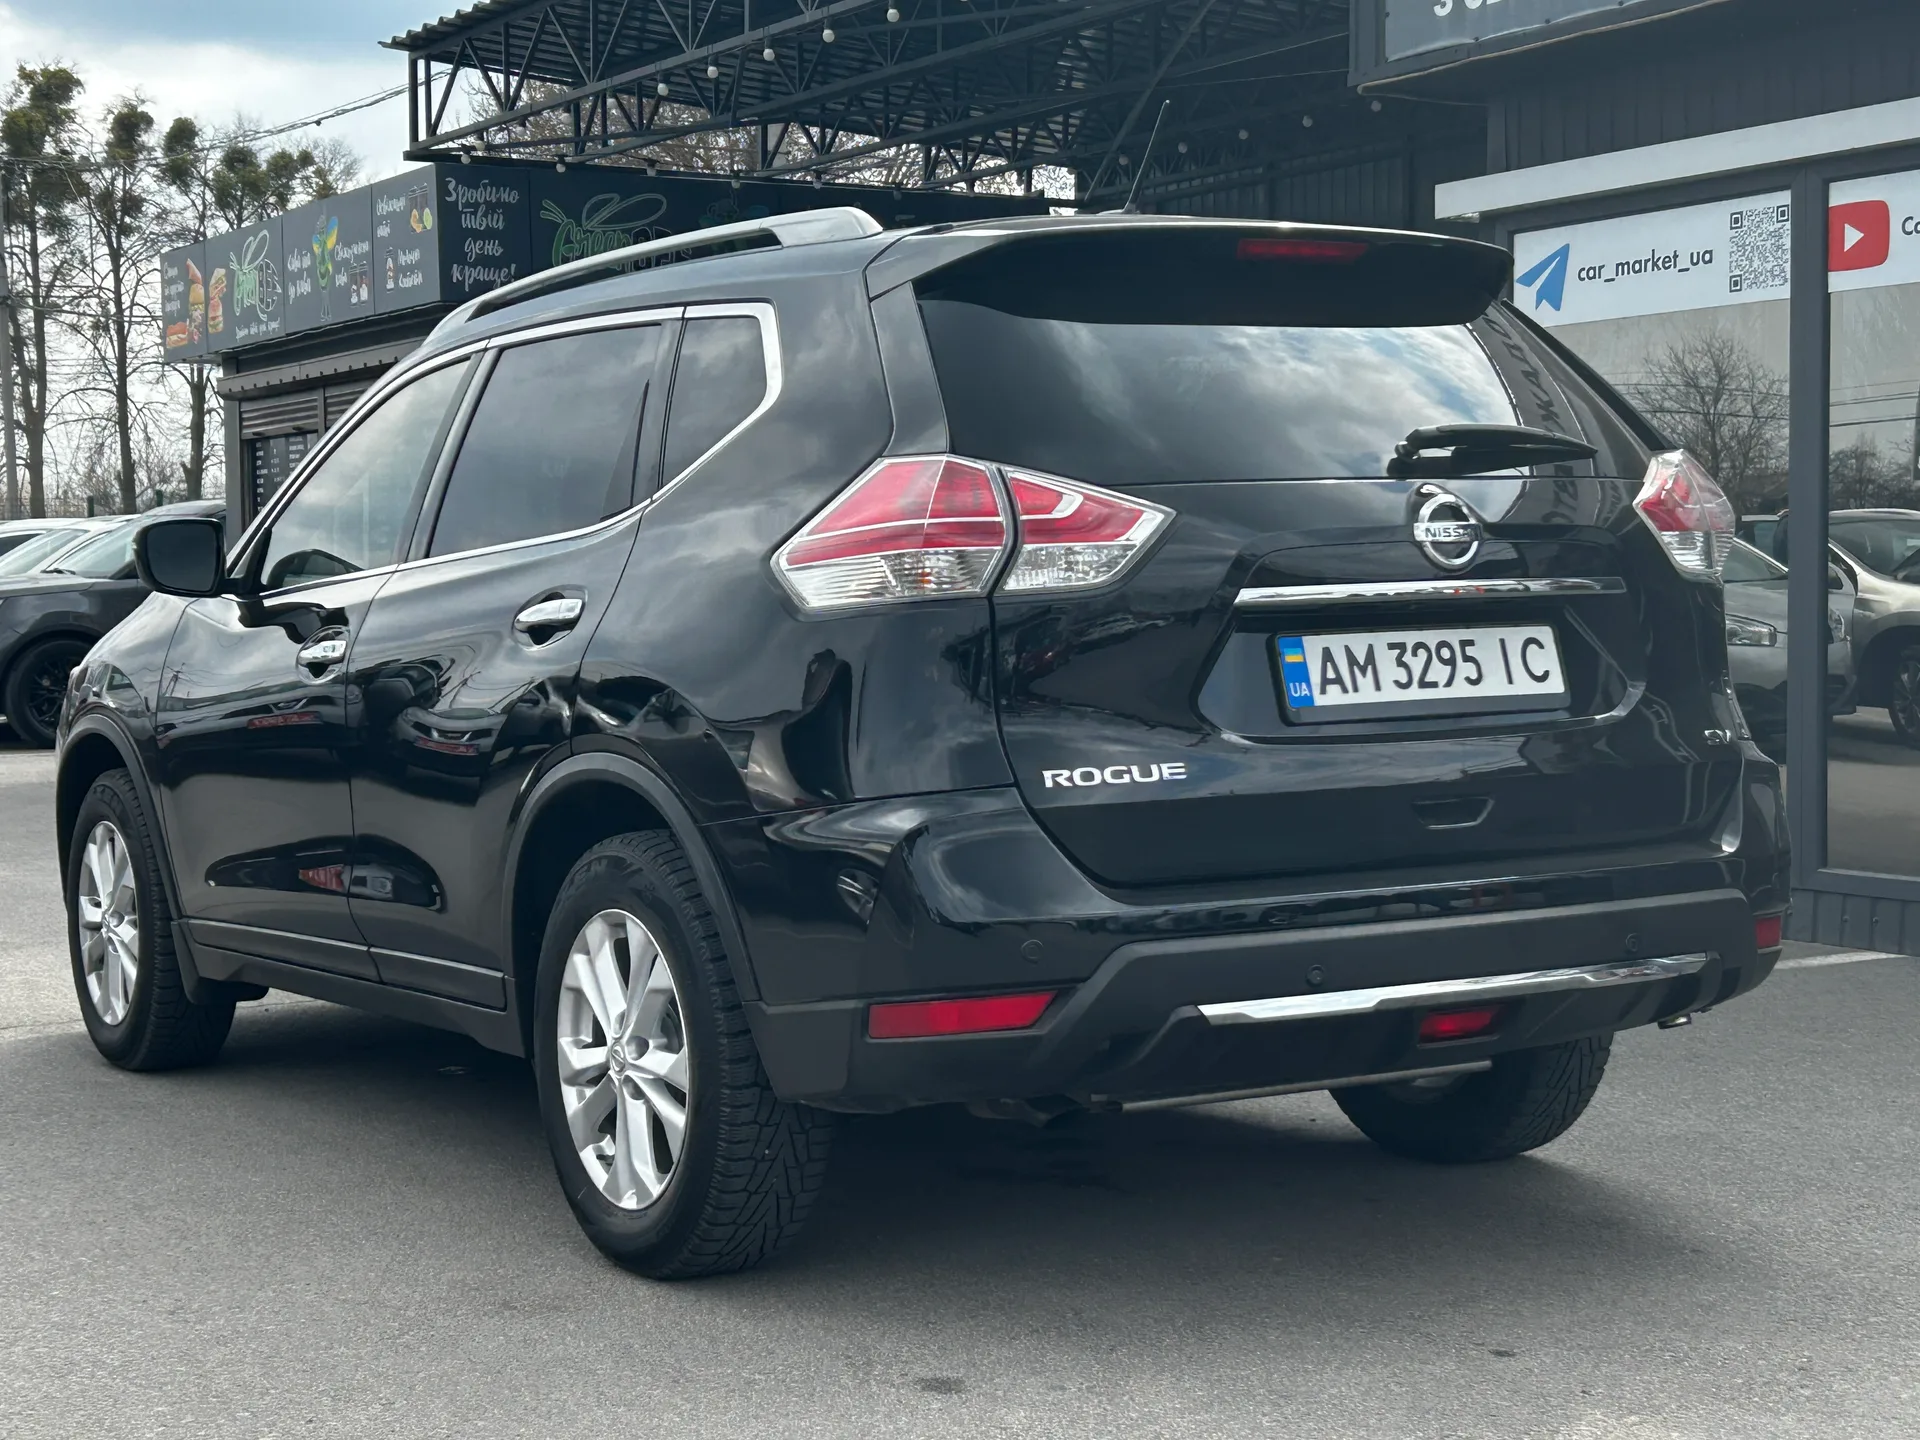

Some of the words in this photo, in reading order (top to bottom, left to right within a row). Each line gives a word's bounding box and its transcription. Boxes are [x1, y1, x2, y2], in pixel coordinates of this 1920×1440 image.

[445, 177, 520, 211] Зробимо
[461, 205, 505, 231] твій
[464, 238, 504, 262] день
[450, 262, 517, 291] краще!
[1577, 247, 1714, 283] car_market_ua
[1319, 643, 1381, 695] AM
[1387, 639, 1483, 689] 3295
[1498, 636, 1550, 686] IC
[1290, 682, 1310, 698] UA
[1042, 762, 1188, 788] ROGUE
